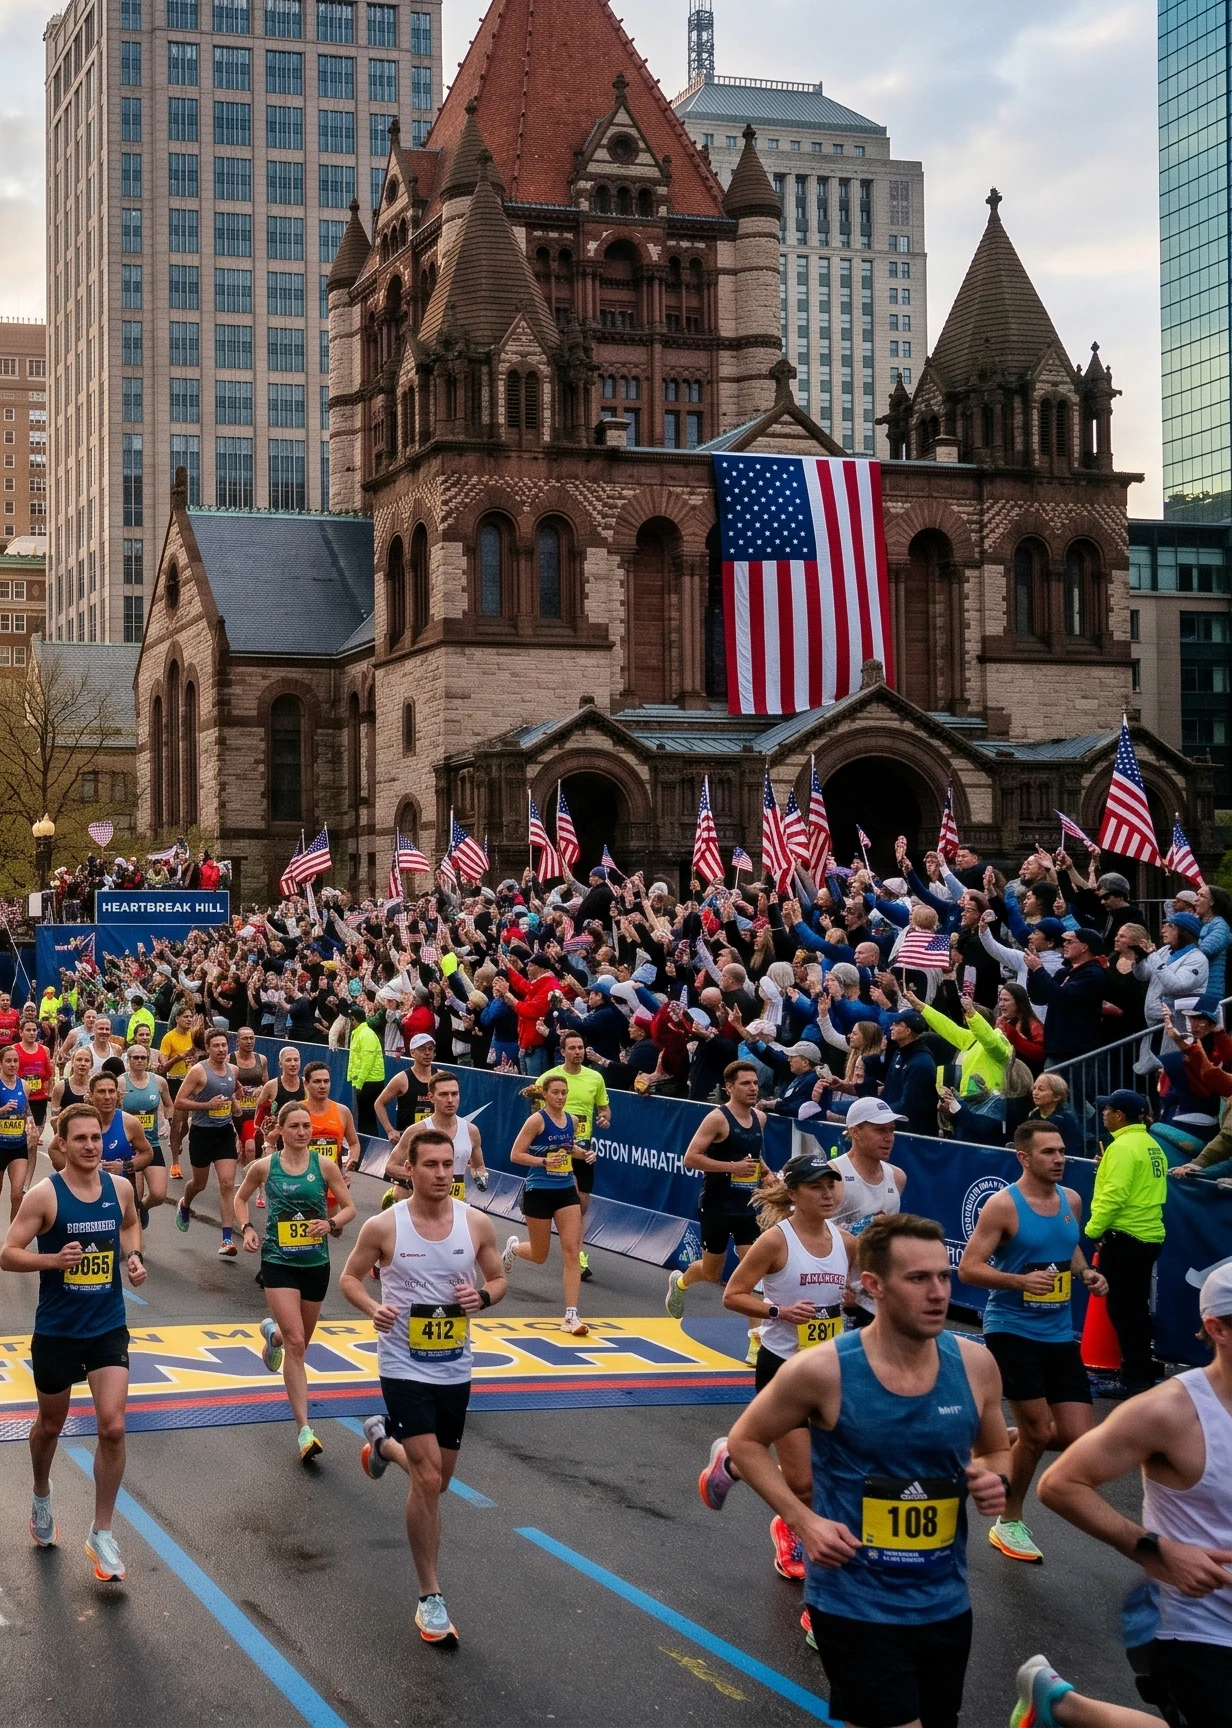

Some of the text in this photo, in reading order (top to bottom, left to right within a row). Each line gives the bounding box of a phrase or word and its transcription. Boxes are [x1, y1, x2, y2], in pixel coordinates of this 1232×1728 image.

[102, 902, 224, 913] HEARTBREAK HILL
[590, 1137, 705, 1178] OSTON MARATH
[421, 1319, 455, 1340] 412
[887, 1505, 938, 1539] 108
